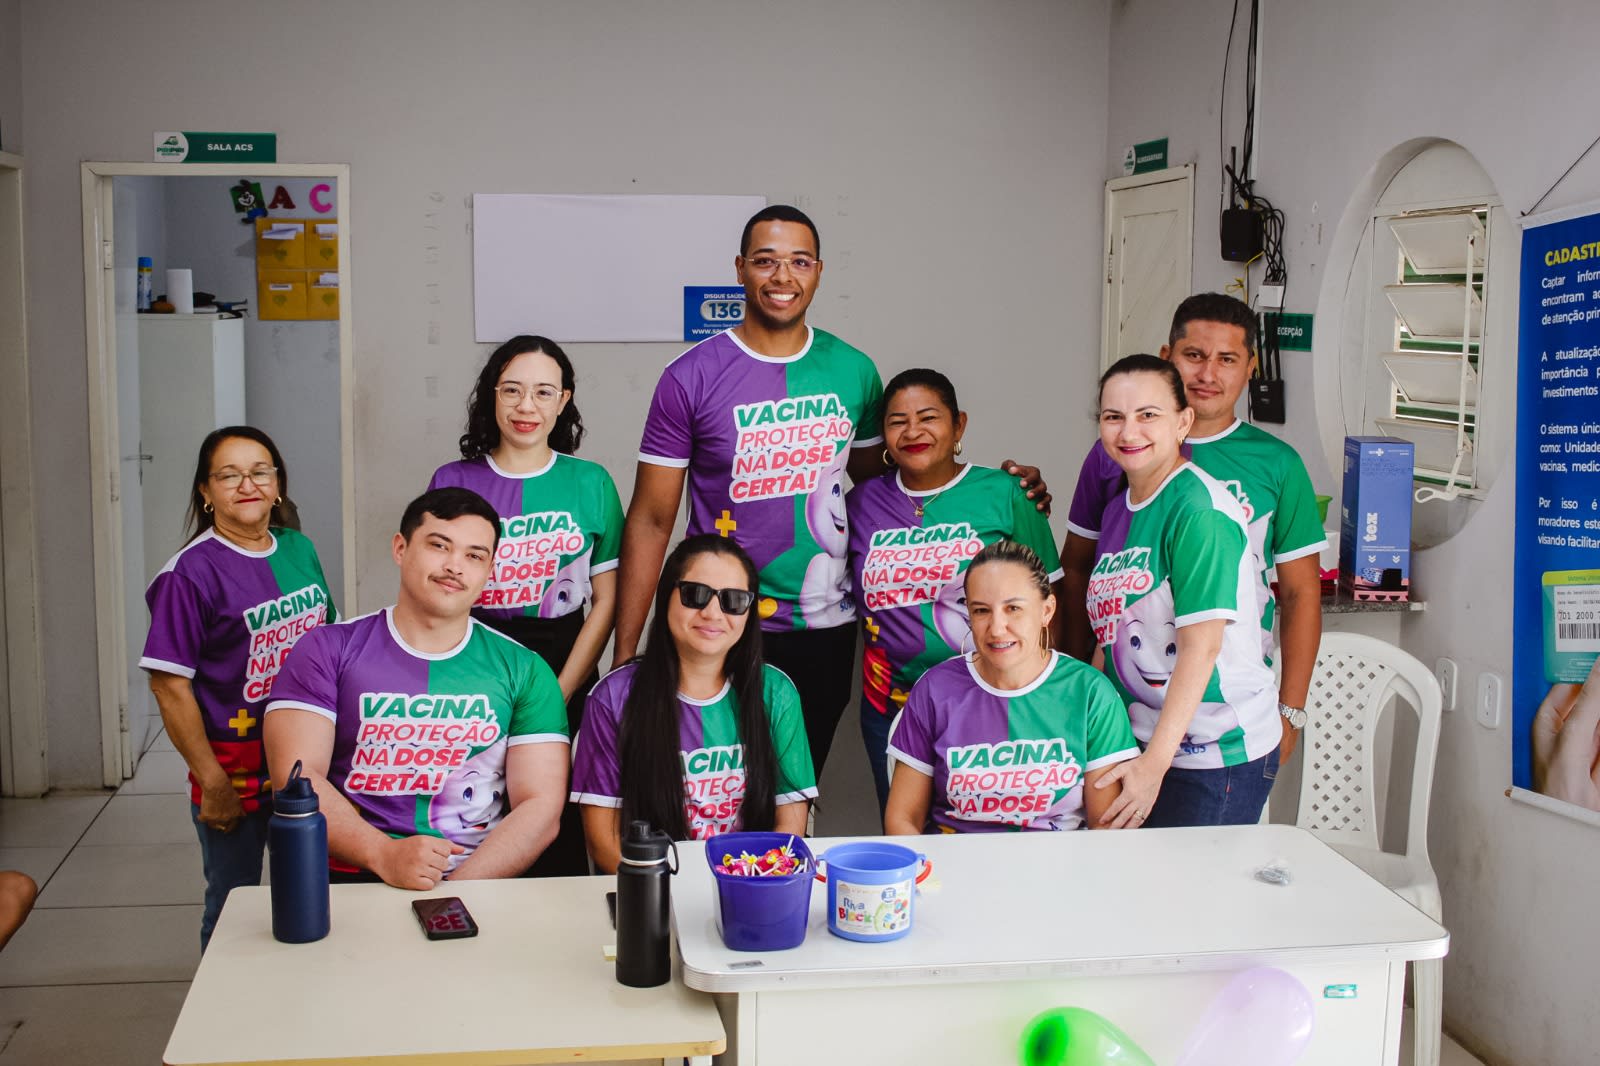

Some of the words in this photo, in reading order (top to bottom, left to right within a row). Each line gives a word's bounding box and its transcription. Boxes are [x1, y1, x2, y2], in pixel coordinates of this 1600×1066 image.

[207, 143, 232, 151] SALA
[234, 143, 254, 152] ACS
[268, 185, 296, 209] A
[309, 184, 333, 213] C
[1541, 275, 1566, 290] Captar
[1541, 291, 1585, 308] encontram
[708, 302, 742, 319] 136
[1541, 313, 1551, 326] de
[1552, 309, 1585, 325] atenção
[1277, 326, 1303, 339] ECEPÇÃO
[1541, 351, 1548, 363] A
[1541, 366, 1589, 382] importância
[1543, 385, 1599, 398] investimentos
[737, 397, 845, 428] VACINA,
[740, 418, 851, 450] PROTEÇÃO
[1540, 424, 1547, 435] O
[1547, 424, 1578, 434] sistema
[735, 454, 767, 475] NA
[771, 444, 833, 470] DOSE
[732, 470, 817, 499] CERTA!
[1538, 497, 1551, 508] Por
[1561, 497, 1579, 510] isso
[1591, 497, 1598, 511] é
[500, 514, 576, 539] CINA,
[1538, 516, 1581, 529] moradores
[497, 532, 582, 561] OTEÇÃO
[873, 525, 973, 547] VACINA,
[1538, 534, 1566, 547] visando
[867, 540, 981, 565] PROTEÇÃO
[500, 559, 557, 583] DOSE
[863, 568, 889, 587] NA
[893, 564, 955, 583] DOSE
[866, 586, 938, 609] CERTA!
[1576, 611, 1594, 620] 2000
[250, 653, 276, 676] NA
[363, 696, 494, 723] VACINA,
[360, 721, 498, 747] PROTEÇÃO
[355, 748, 389, 766] NA
[393, 748, 467, 767] DOSE
[951, 742, 1071, 769] VACINA,
[347, 771, 444, 792] CERTA!
[950, 763, 1078, 794] PROTEÇÃO
[981, 794, 1051, 813] DOSE
